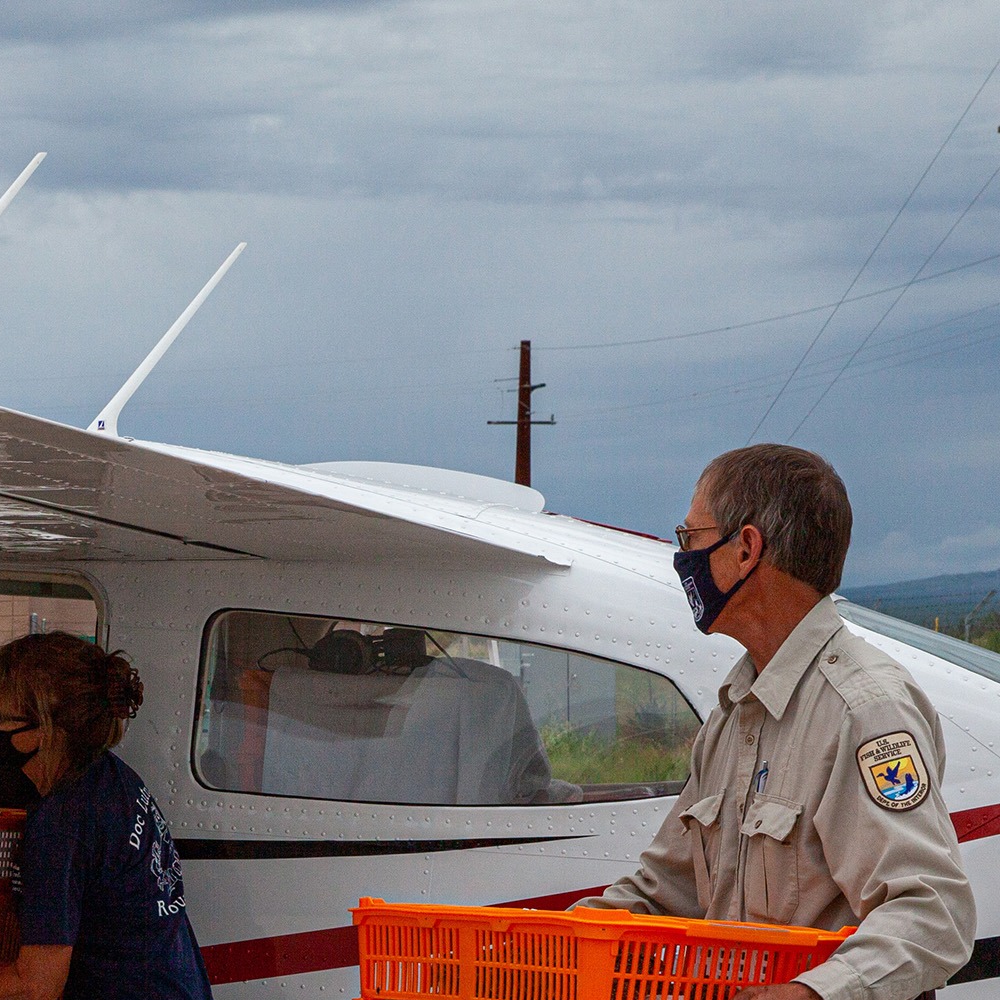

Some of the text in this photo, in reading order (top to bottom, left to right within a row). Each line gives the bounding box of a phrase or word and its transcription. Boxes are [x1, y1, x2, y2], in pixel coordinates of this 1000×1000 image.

[860, 750, 875, 761] FISH
[880, 740, 911, 752] WILDLIFE
[874, 749, 902, 762] SERVICE
[130, 814, 145, 850] Doc
